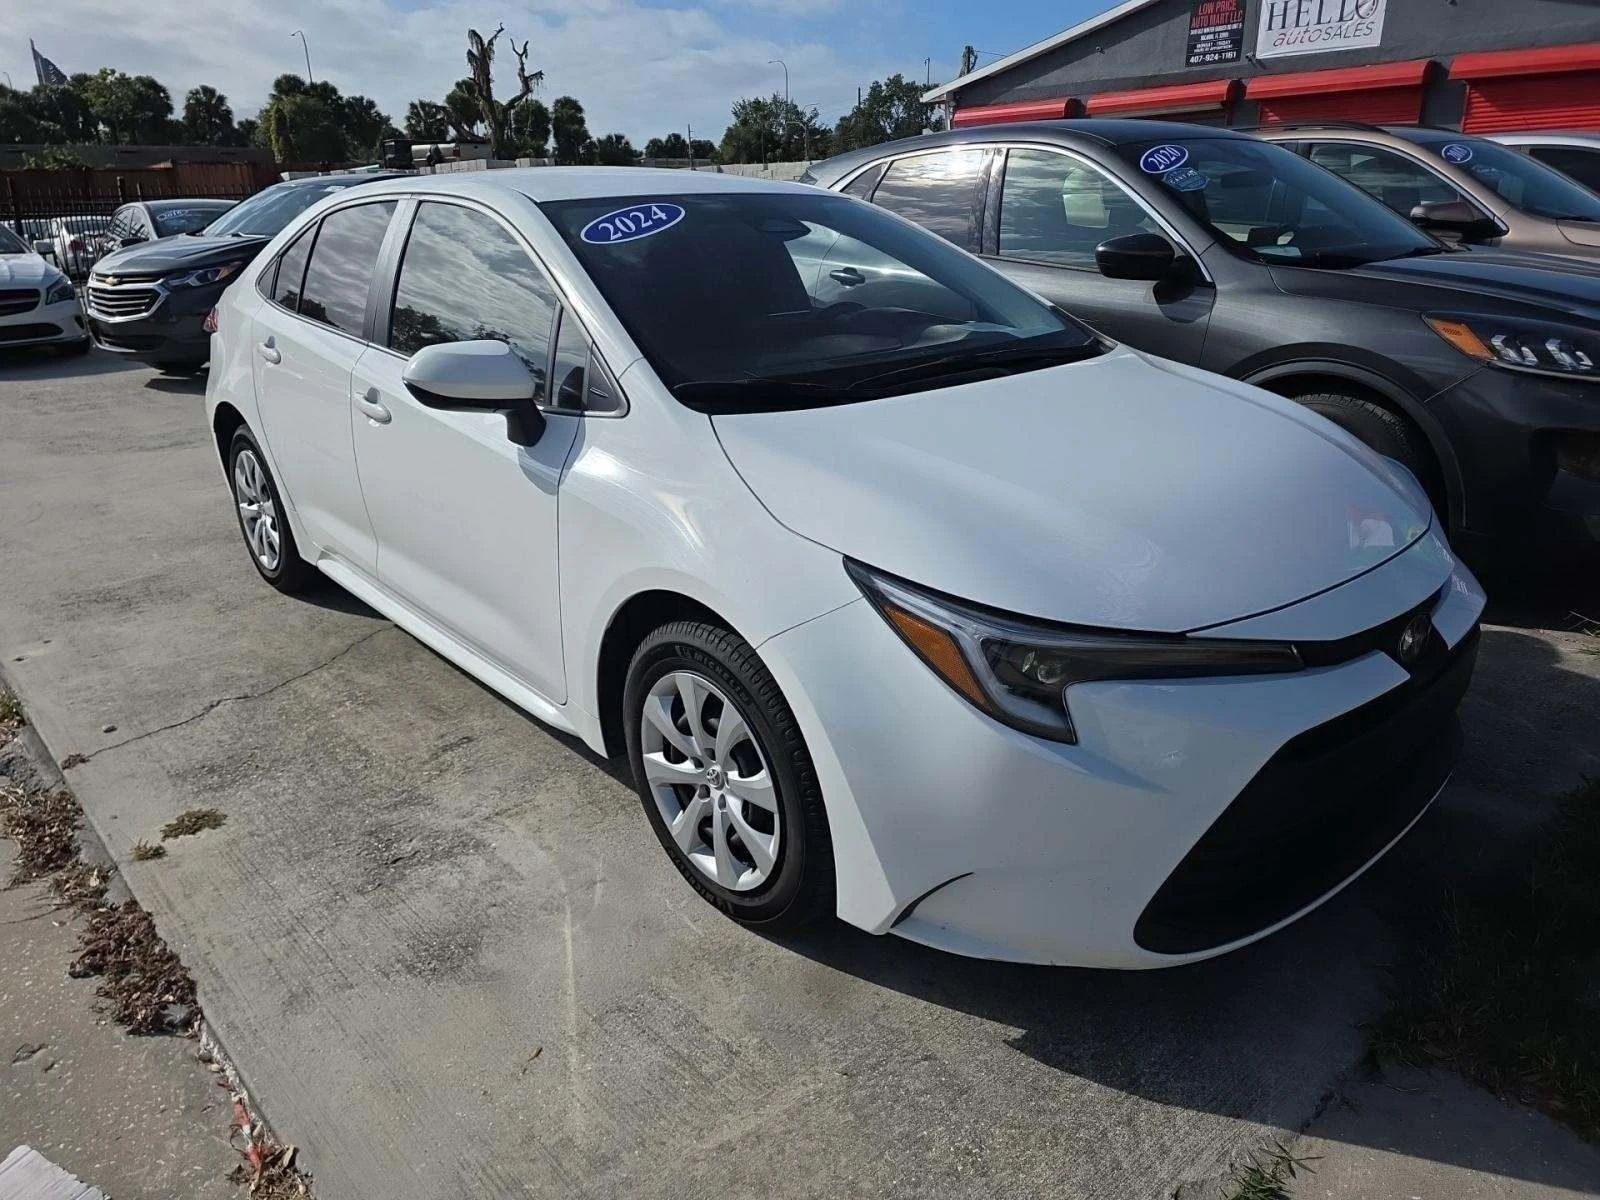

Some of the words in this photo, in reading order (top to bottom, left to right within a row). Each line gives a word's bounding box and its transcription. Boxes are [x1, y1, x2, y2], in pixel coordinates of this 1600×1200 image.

[1191, 15, 1209, 29] AUTO
[1209, 11, 1230, 26] MART
[1230, 10, 1243, 23] LLC
[1199, 2, 1215, 15] LOW
[1216, 0, 1237, 12] PRICE
[1266, 0, 1378, 31] HELLO
[1148, 146, 1181, 170] 2020
[598, 205, 668, 240] 2024
